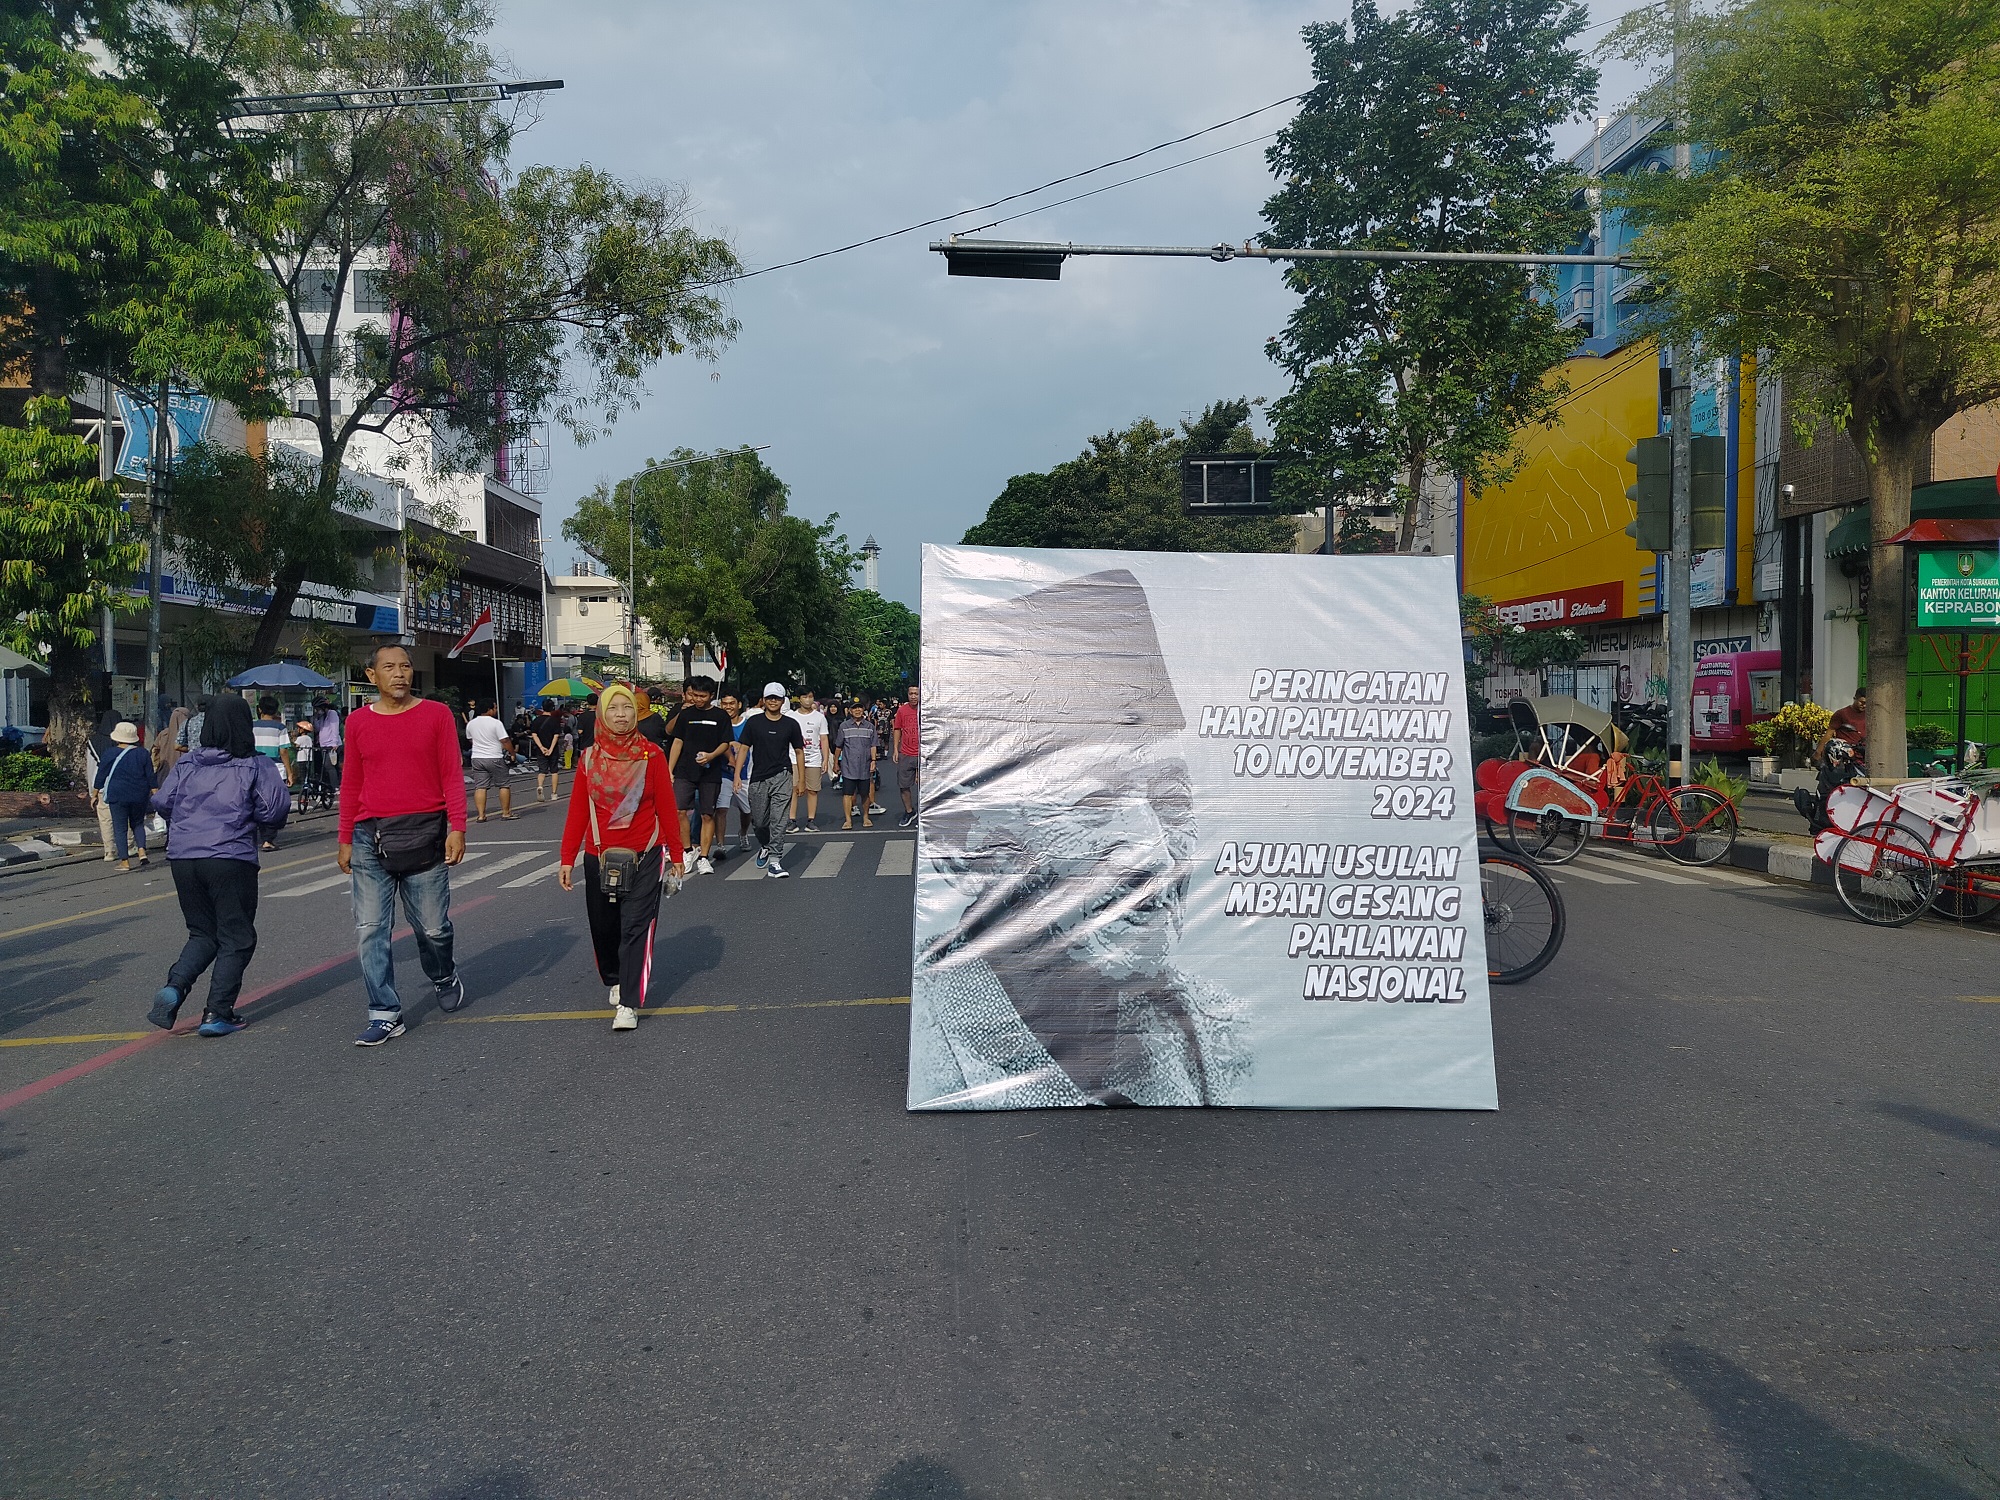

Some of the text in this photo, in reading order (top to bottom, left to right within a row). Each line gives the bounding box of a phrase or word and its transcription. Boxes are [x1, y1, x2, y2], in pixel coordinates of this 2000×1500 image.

[1920, 587, 1956, 600] KANTOR
[1973, 578, 1999, 586] SURAKARTA
[1499, 598, 1565, 625] SEMERU
[1696, 639, 1748, 660] SONY
[1249, 668, 1449, 704] PERINGATAN
[1199, 705, 1451, 743] HARI PAHLAWAN
[1233, 744, 1453, 781] 10 NOVEMBER
[1371, 785, 1456, 820] 2024
[1214, 842, 1461, 881] AJUAN USULAN
[1224, 881, 1462, 922] MBAH GESANG
[1288, 922, 1467, 962] PAHLAWAN
[1303, 964, 1467, 1003] NASIONAL
